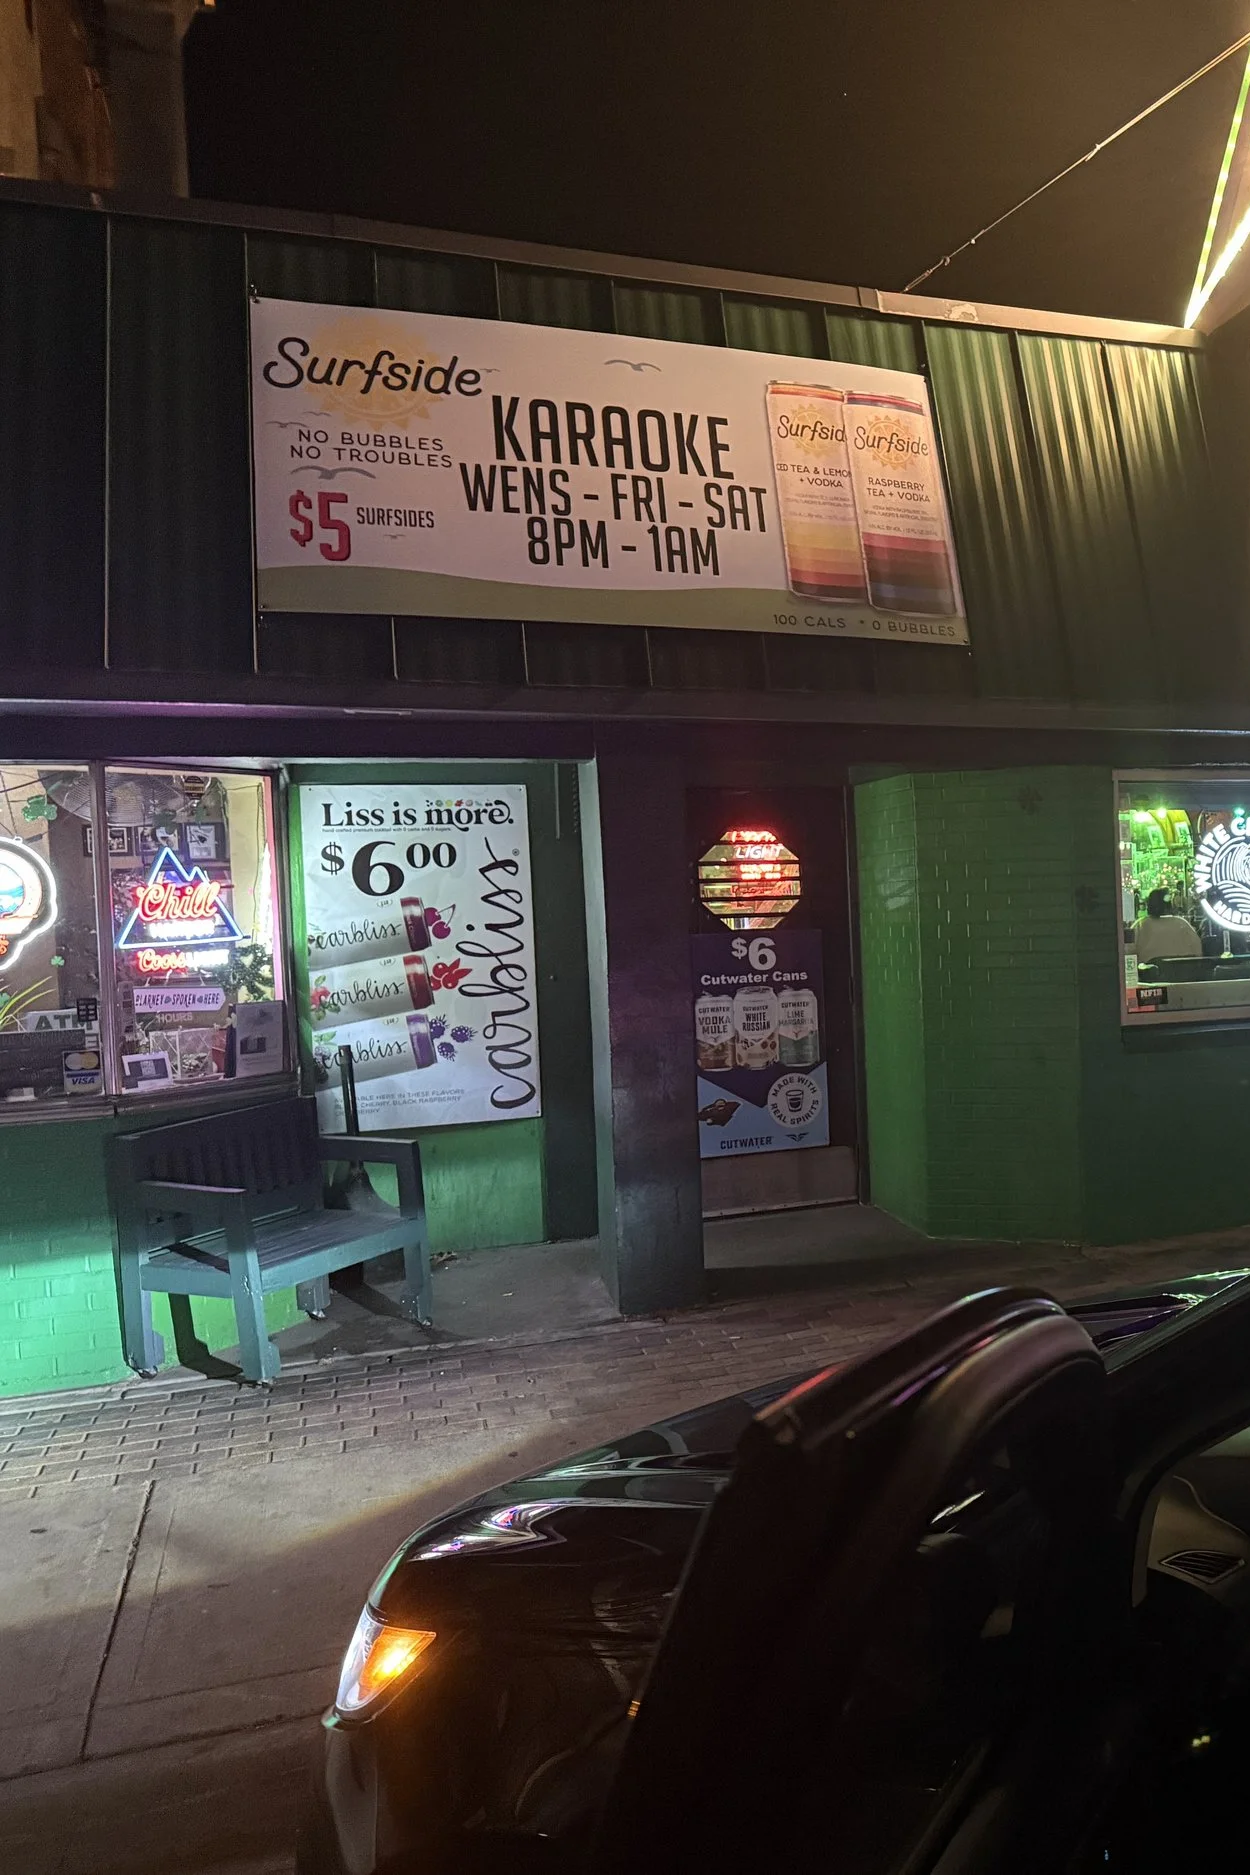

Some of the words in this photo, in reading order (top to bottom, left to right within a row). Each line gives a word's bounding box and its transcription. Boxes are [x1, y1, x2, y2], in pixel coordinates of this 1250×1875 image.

[263, 337, 482, 396] Surfside
[298, 429, 329, 443] NO
[341, 432, 444, 451] BUBBLES
[492, 395, 734, 480] KARAOKE
[777, 415, 847, 443] Surfsid
[854, 426, 929, 456] Surfside
[290, 445, 321, 460] NO
[334, 448, 452, 468] TROUBLES
[790, 464, 810, 474] TEA
[813, 467, 820, 475] &
[807, 477, 844, 489] VODKA
[868, 477, 925, 491] RASPBERRY
[459, 463, 572, 516] WENS
[610, 473, 667, 523] FRI
[703, 482, 767, 532] SAT
[866, 488, 886, 498] TEA
[898, 492, 931, 503] VODKA
[289, 489, 351, 561] $5
[356, 507, 435, 529] SURFSIDES
[527, 516, 609, 569] 8PM
[647, 524, 720, 576] 1AM
[773, 614, 797, 627] 100
[804, 615, 847, 629] CALS
[887, 620, 956, 637] BUBBLES
[321, 801, 384, 826] Liss
[392, 801, 417, 826] is
[735, 843, 784, 859] LIGHT
[1194, 823, 1231, 894] WHITE
[137, 881, 221, 921] Chill
[136, 948, 188, 973] Coors
[731, 937, 777, 971] $6
[701, 972, 768, 986] Cutwater
[772, 970, 808, 982] Cans
[172, 993, 196, 1007] SPOKEN
[204, 993, 219, 1005] HERE
[157, 1012, 192, 1023] HOURS
[698, 1016, 732, 1025] VODKA
[745, 1012, 766, 1022] WHITE
[787, 1010, 804, 1018] LIME
[702, 1025, 728, 1034] MULE
[742, 1021, 771, 1032] RUSSIAN
[72, 1077, 95, 1085] VISA
[772, 1076, 794, 1097] MADE
[797, 1076, 817, 1094] WITH
[770, 1103, 787, 1123] REAL
[790, 1099, 819, 1125] SPIRITS
[720, 1135, 772, 1150] CUTWATER
